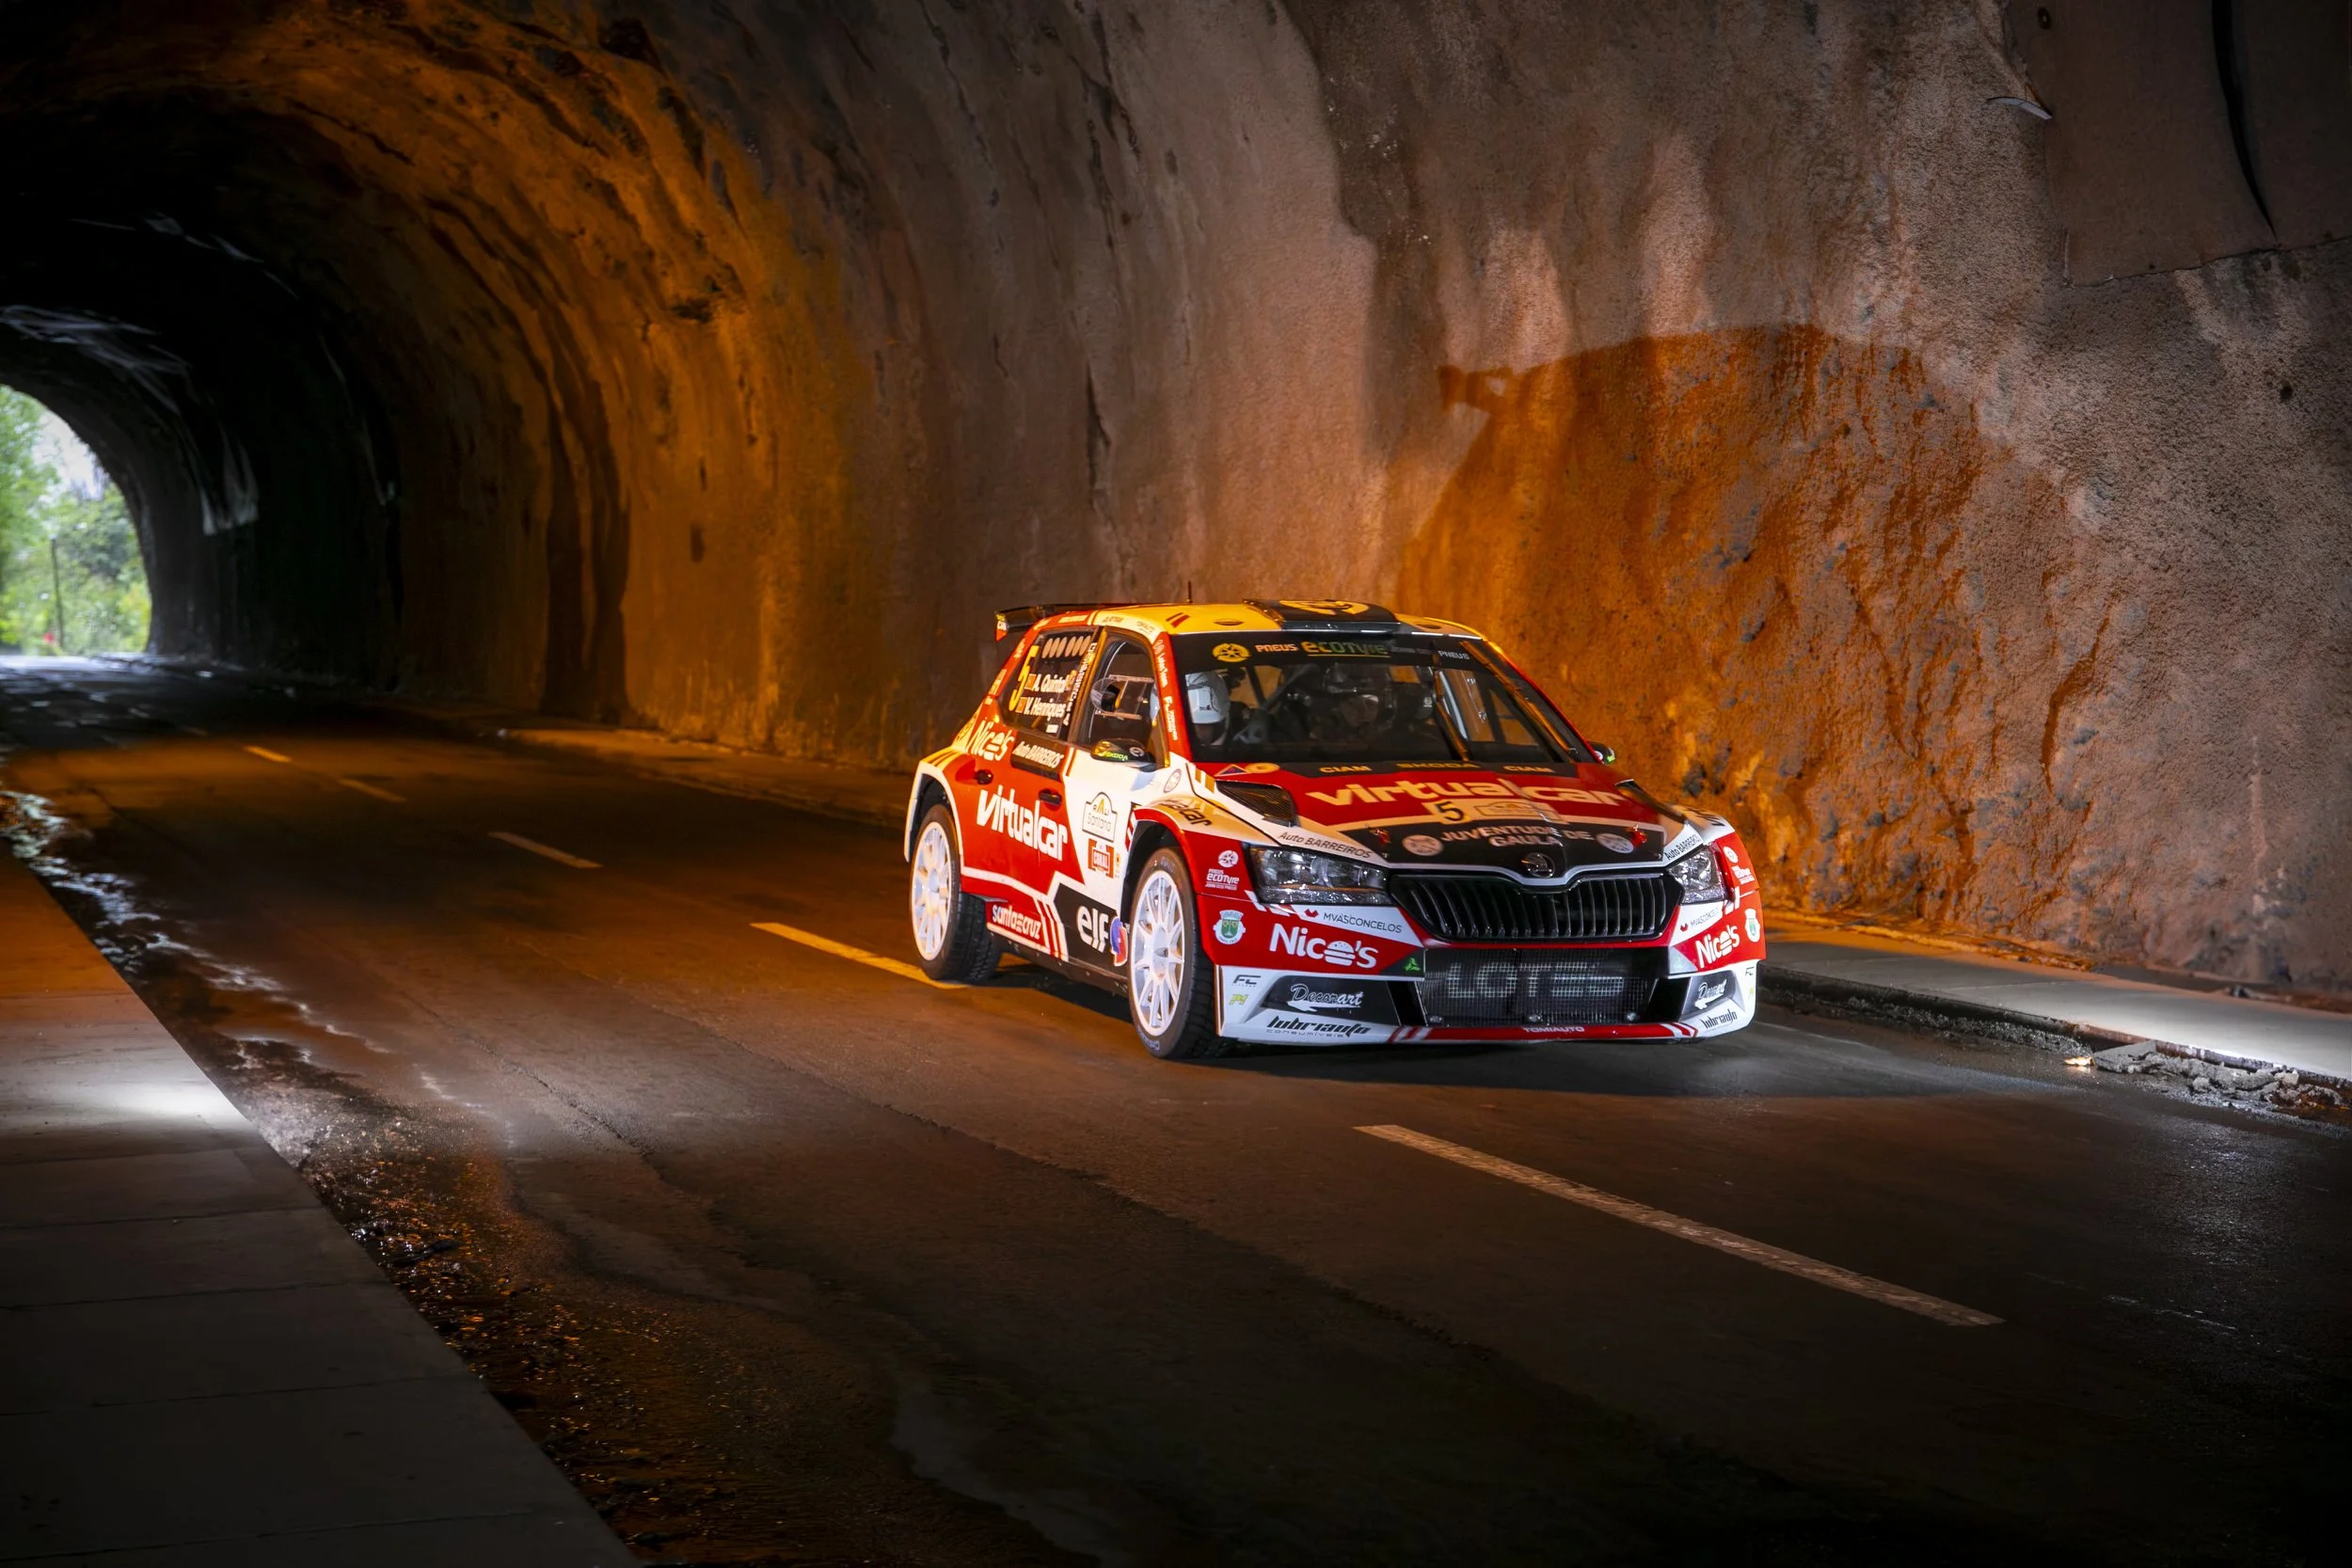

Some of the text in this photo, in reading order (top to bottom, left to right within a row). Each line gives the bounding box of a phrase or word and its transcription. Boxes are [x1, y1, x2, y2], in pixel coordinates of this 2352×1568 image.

[1256, 643, 1297, 653] PNEUS
[1009, 645, 1040, 711] 5
[1030, 697, 1067, 721] Henriques
[1025, 744, 1065, 768] BARREIROS
[1503, 765, 1556, 773] CIAM
[1435, 800, 1465, 821] 5
[1440, 825, 1595, 841] JUVENTUDE DE
[1489, 836, 1564, 847] GAULA
[1279, 832, 1374, 858] Auto BARREIROS
[1663, 847, 1680, 861] Auto
[1076, 906, 1109, 954] elf
[1323, 912, 1403, 934] MVASCONCELOS
[1291, 983, 1363, 1006] Decorart
